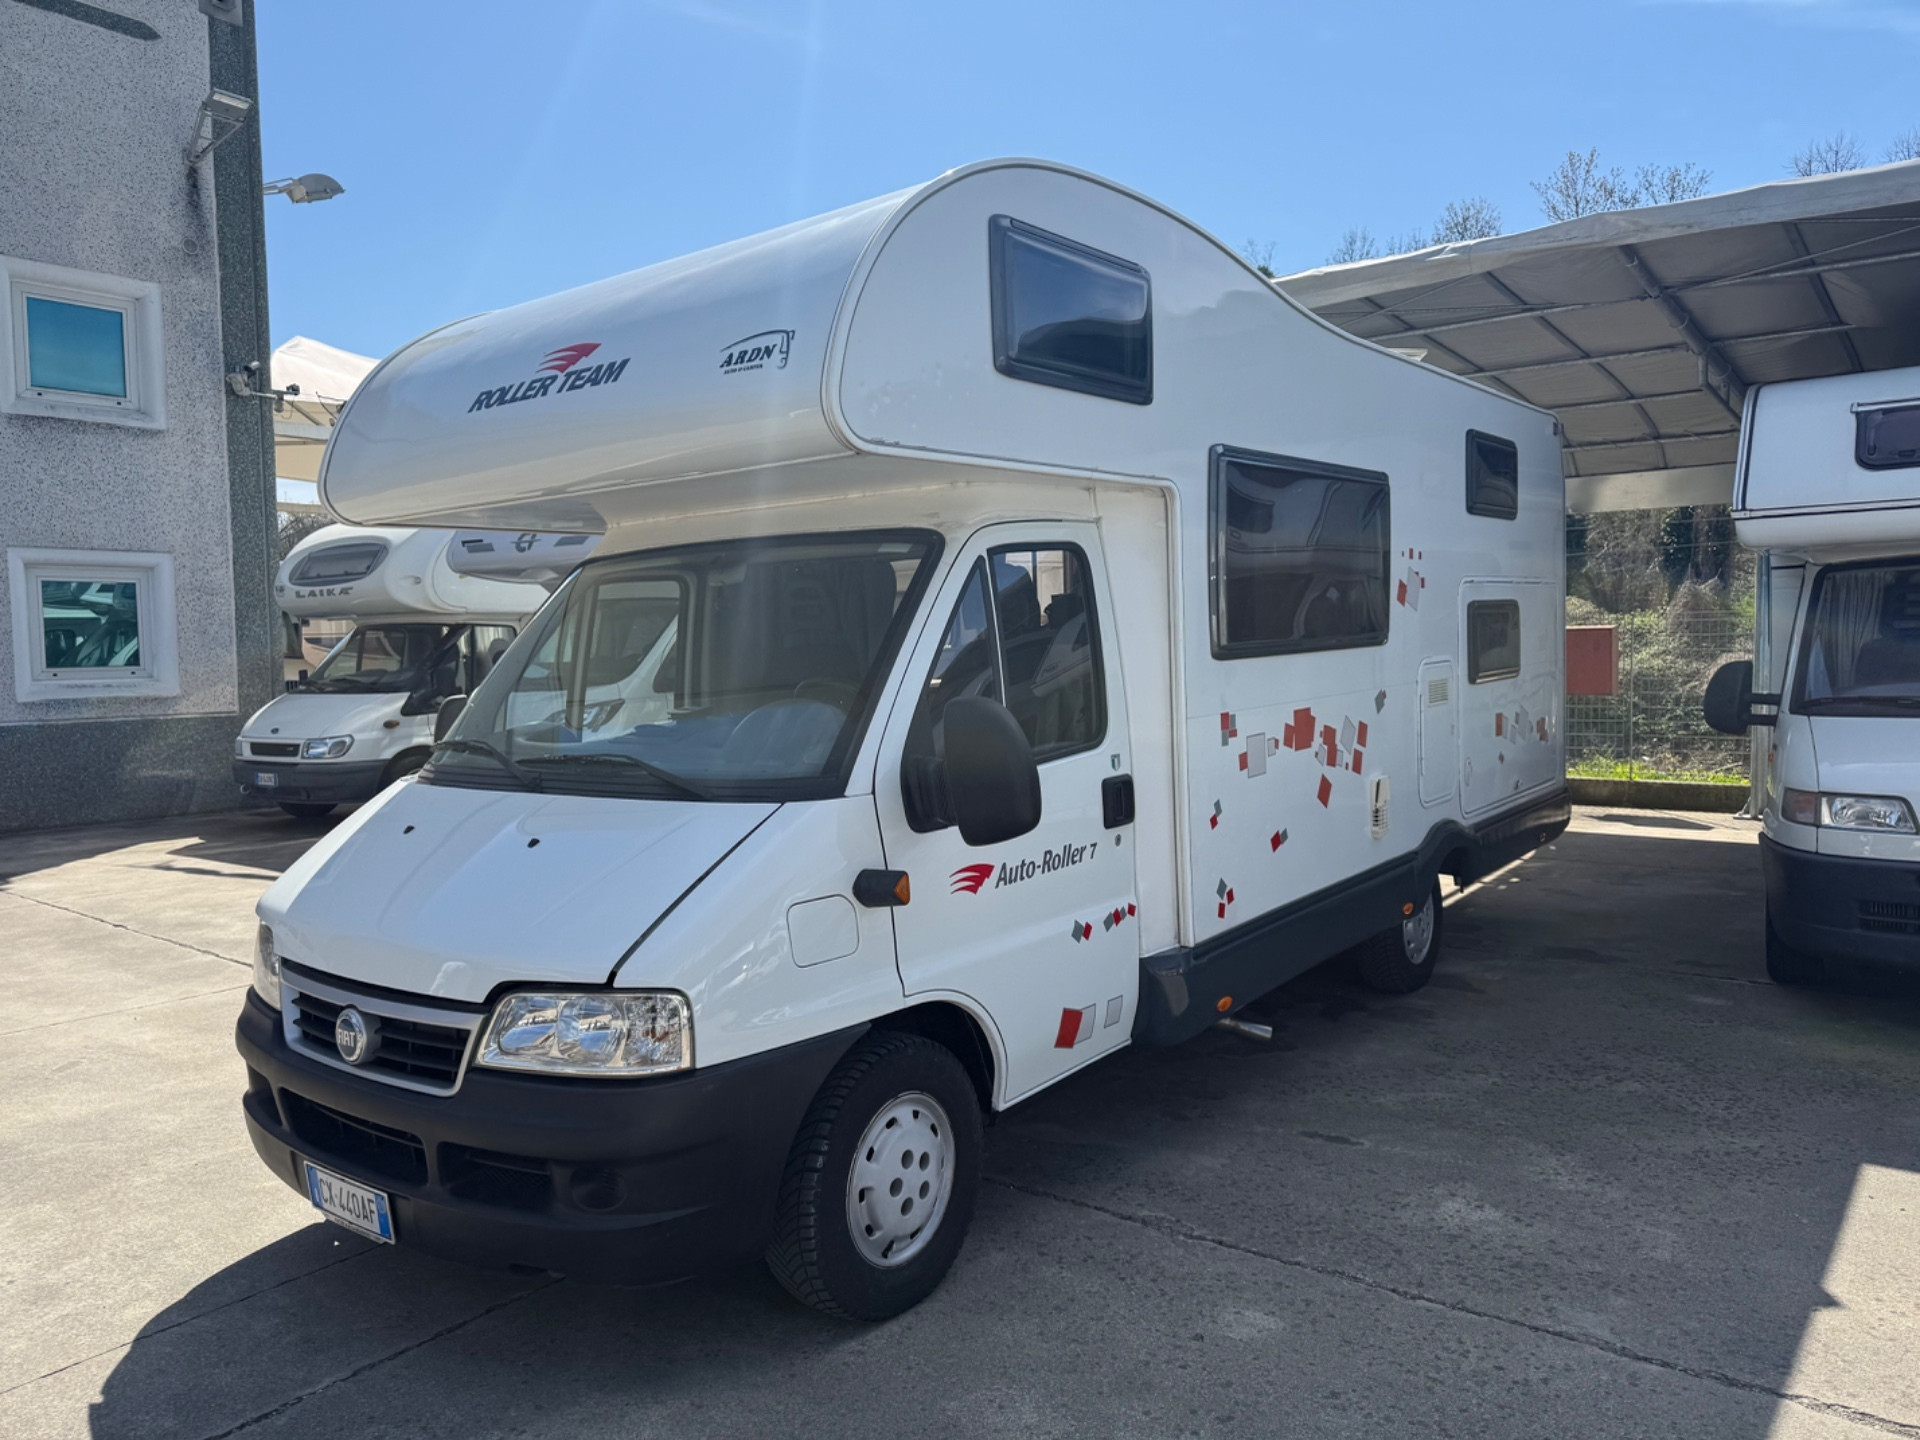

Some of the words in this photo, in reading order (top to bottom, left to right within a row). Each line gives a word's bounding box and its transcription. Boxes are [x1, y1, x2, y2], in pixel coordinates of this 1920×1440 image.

[719, 343, 778, 368] ARDN
[467, 374, 558, 413] ROLLER
[556, 357, 631, 394] TEAM
[295, 586, 354, 599] LAIKA
[995, 843, 1087, 889] Auto-Roller
[1090, 842, 1098, 859] 7
[338, 1029, 356, 1048] FIAT
